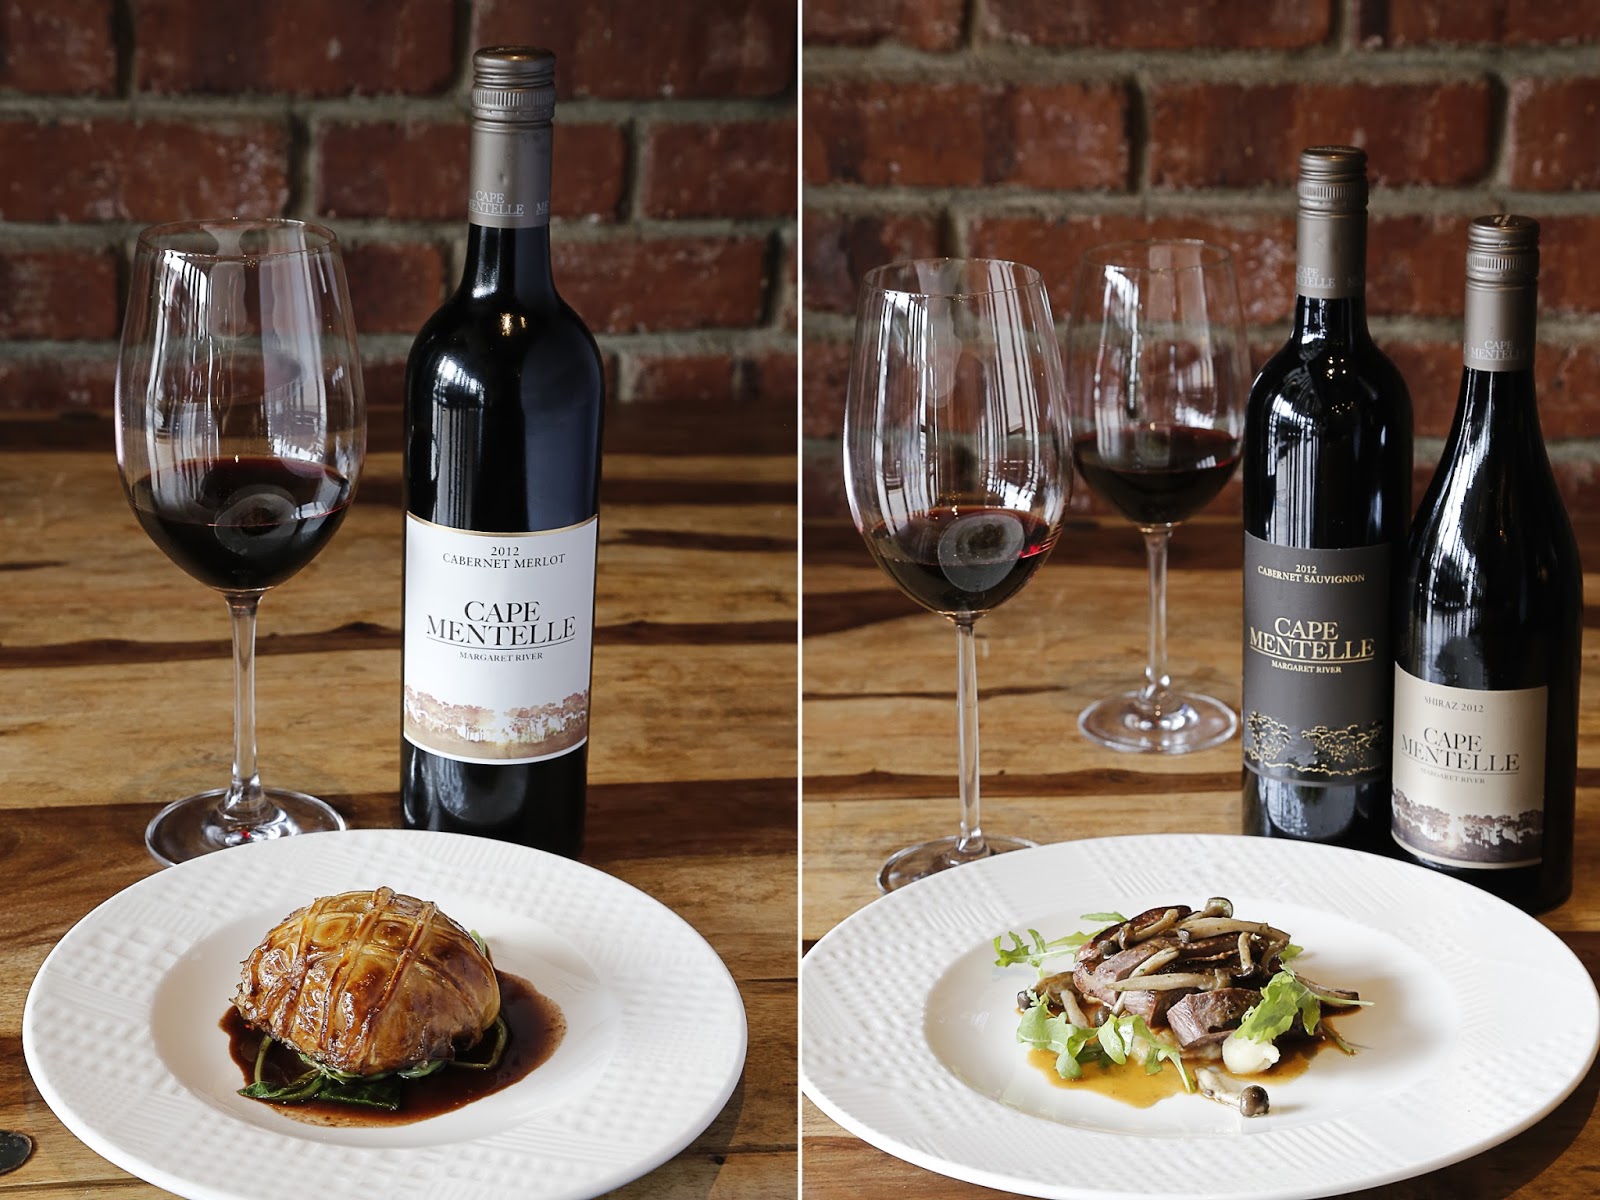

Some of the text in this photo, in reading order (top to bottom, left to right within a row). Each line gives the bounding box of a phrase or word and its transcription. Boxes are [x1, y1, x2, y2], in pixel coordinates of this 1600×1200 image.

[476, 190, 505, 204] CAPE
[1297, 265, 1319, 277] CAPE
[1484, 340, 1514, 350] CAPE
[491, 546, 519, 556] 2012
[443, 553, 566, 569] CABERNET MERLOT
[1295, 564, 1317, 574] 2012
[1258, 565, 1365, 584] CABERNET SAUVIGNON
[464, 600, 540, 623] CAPE
[427, 614, 576, 646] MENTELLE
[1274, 617, 1339, 640] CAPE
[1250, 626, 1375, 660] MENTELLE
[460, 651, 543, 662] MARGARET RIVER
[1271, 659, 1342, 674] MARGARET RIVER
[1424, 695, 1484, 713] SHIRAZ 2012
[1424, 727, 1482, 752] CAPE
[1402, 734, 1520, 772] MENTELLE
[1461, 776, 1485, 784] RIVER
